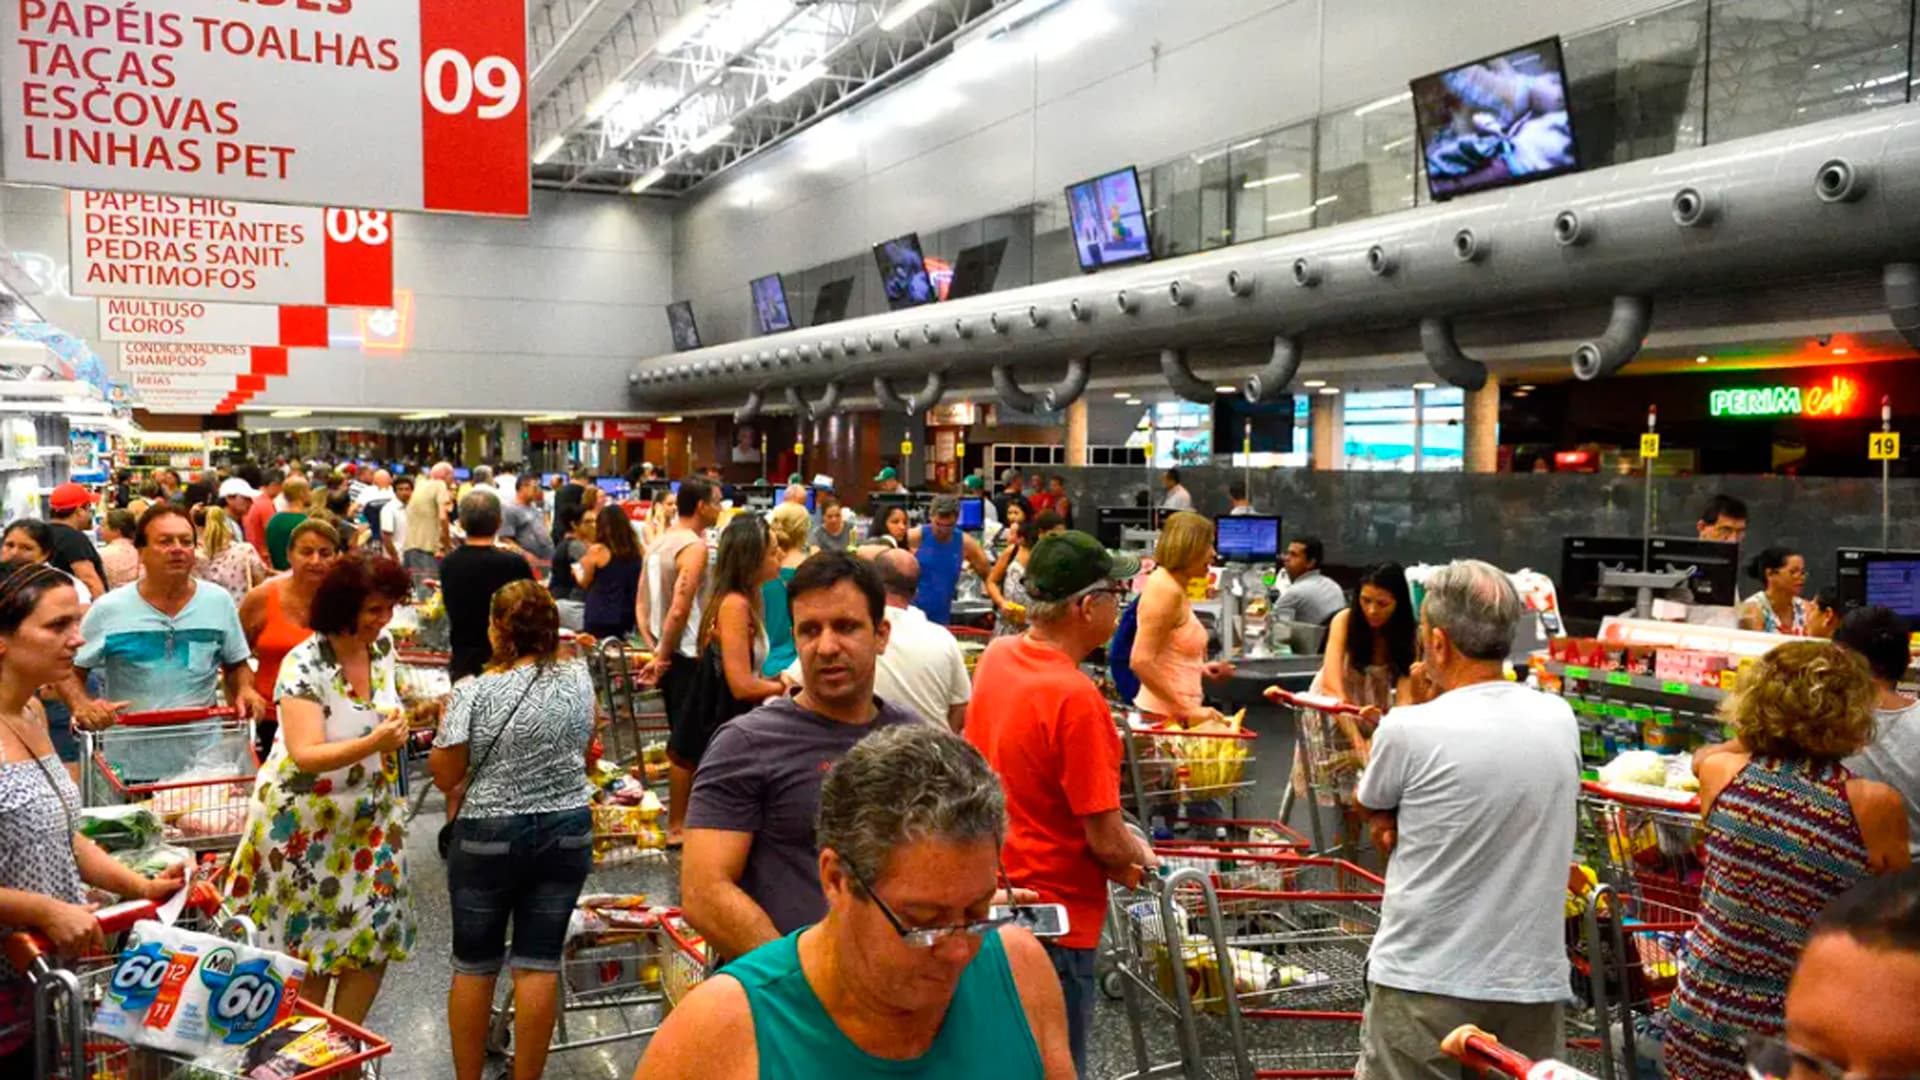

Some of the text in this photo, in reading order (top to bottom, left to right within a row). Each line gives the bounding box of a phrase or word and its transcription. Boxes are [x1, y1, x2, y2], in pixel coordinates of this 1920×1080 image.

[19, 0, 400, 71] PAPÉIS TOALHAS
[18, 38, 177, 92] TAÇAS
[424, 48, 521, 120] 09
[22, 81, 240, 135] ESCOVAS
[25, 125, 296, 180] LINHAS PET
[188, 199, 237, 218] HIG
[85, 213, 304, 244] DESINFETANTES
[326, 207, 388, 245] 08
[86, 237, 290, 267] PEDRAS SANIT.
[86, 262, 257, 290] ANTIMOFOS
[108, 299, 205, 318] MULTIUSO
[108, 318, 185, 334] CLOROS
[126, 355, 206, 366] SHAMPOOS
[1874, 438, 1895, 455] 19
[114, 955, 169, 989] 60
[167, 962, 187, 982] 12
[153, 1002, 170, 1019] 11
[218, 974, 276, 1021] 60
